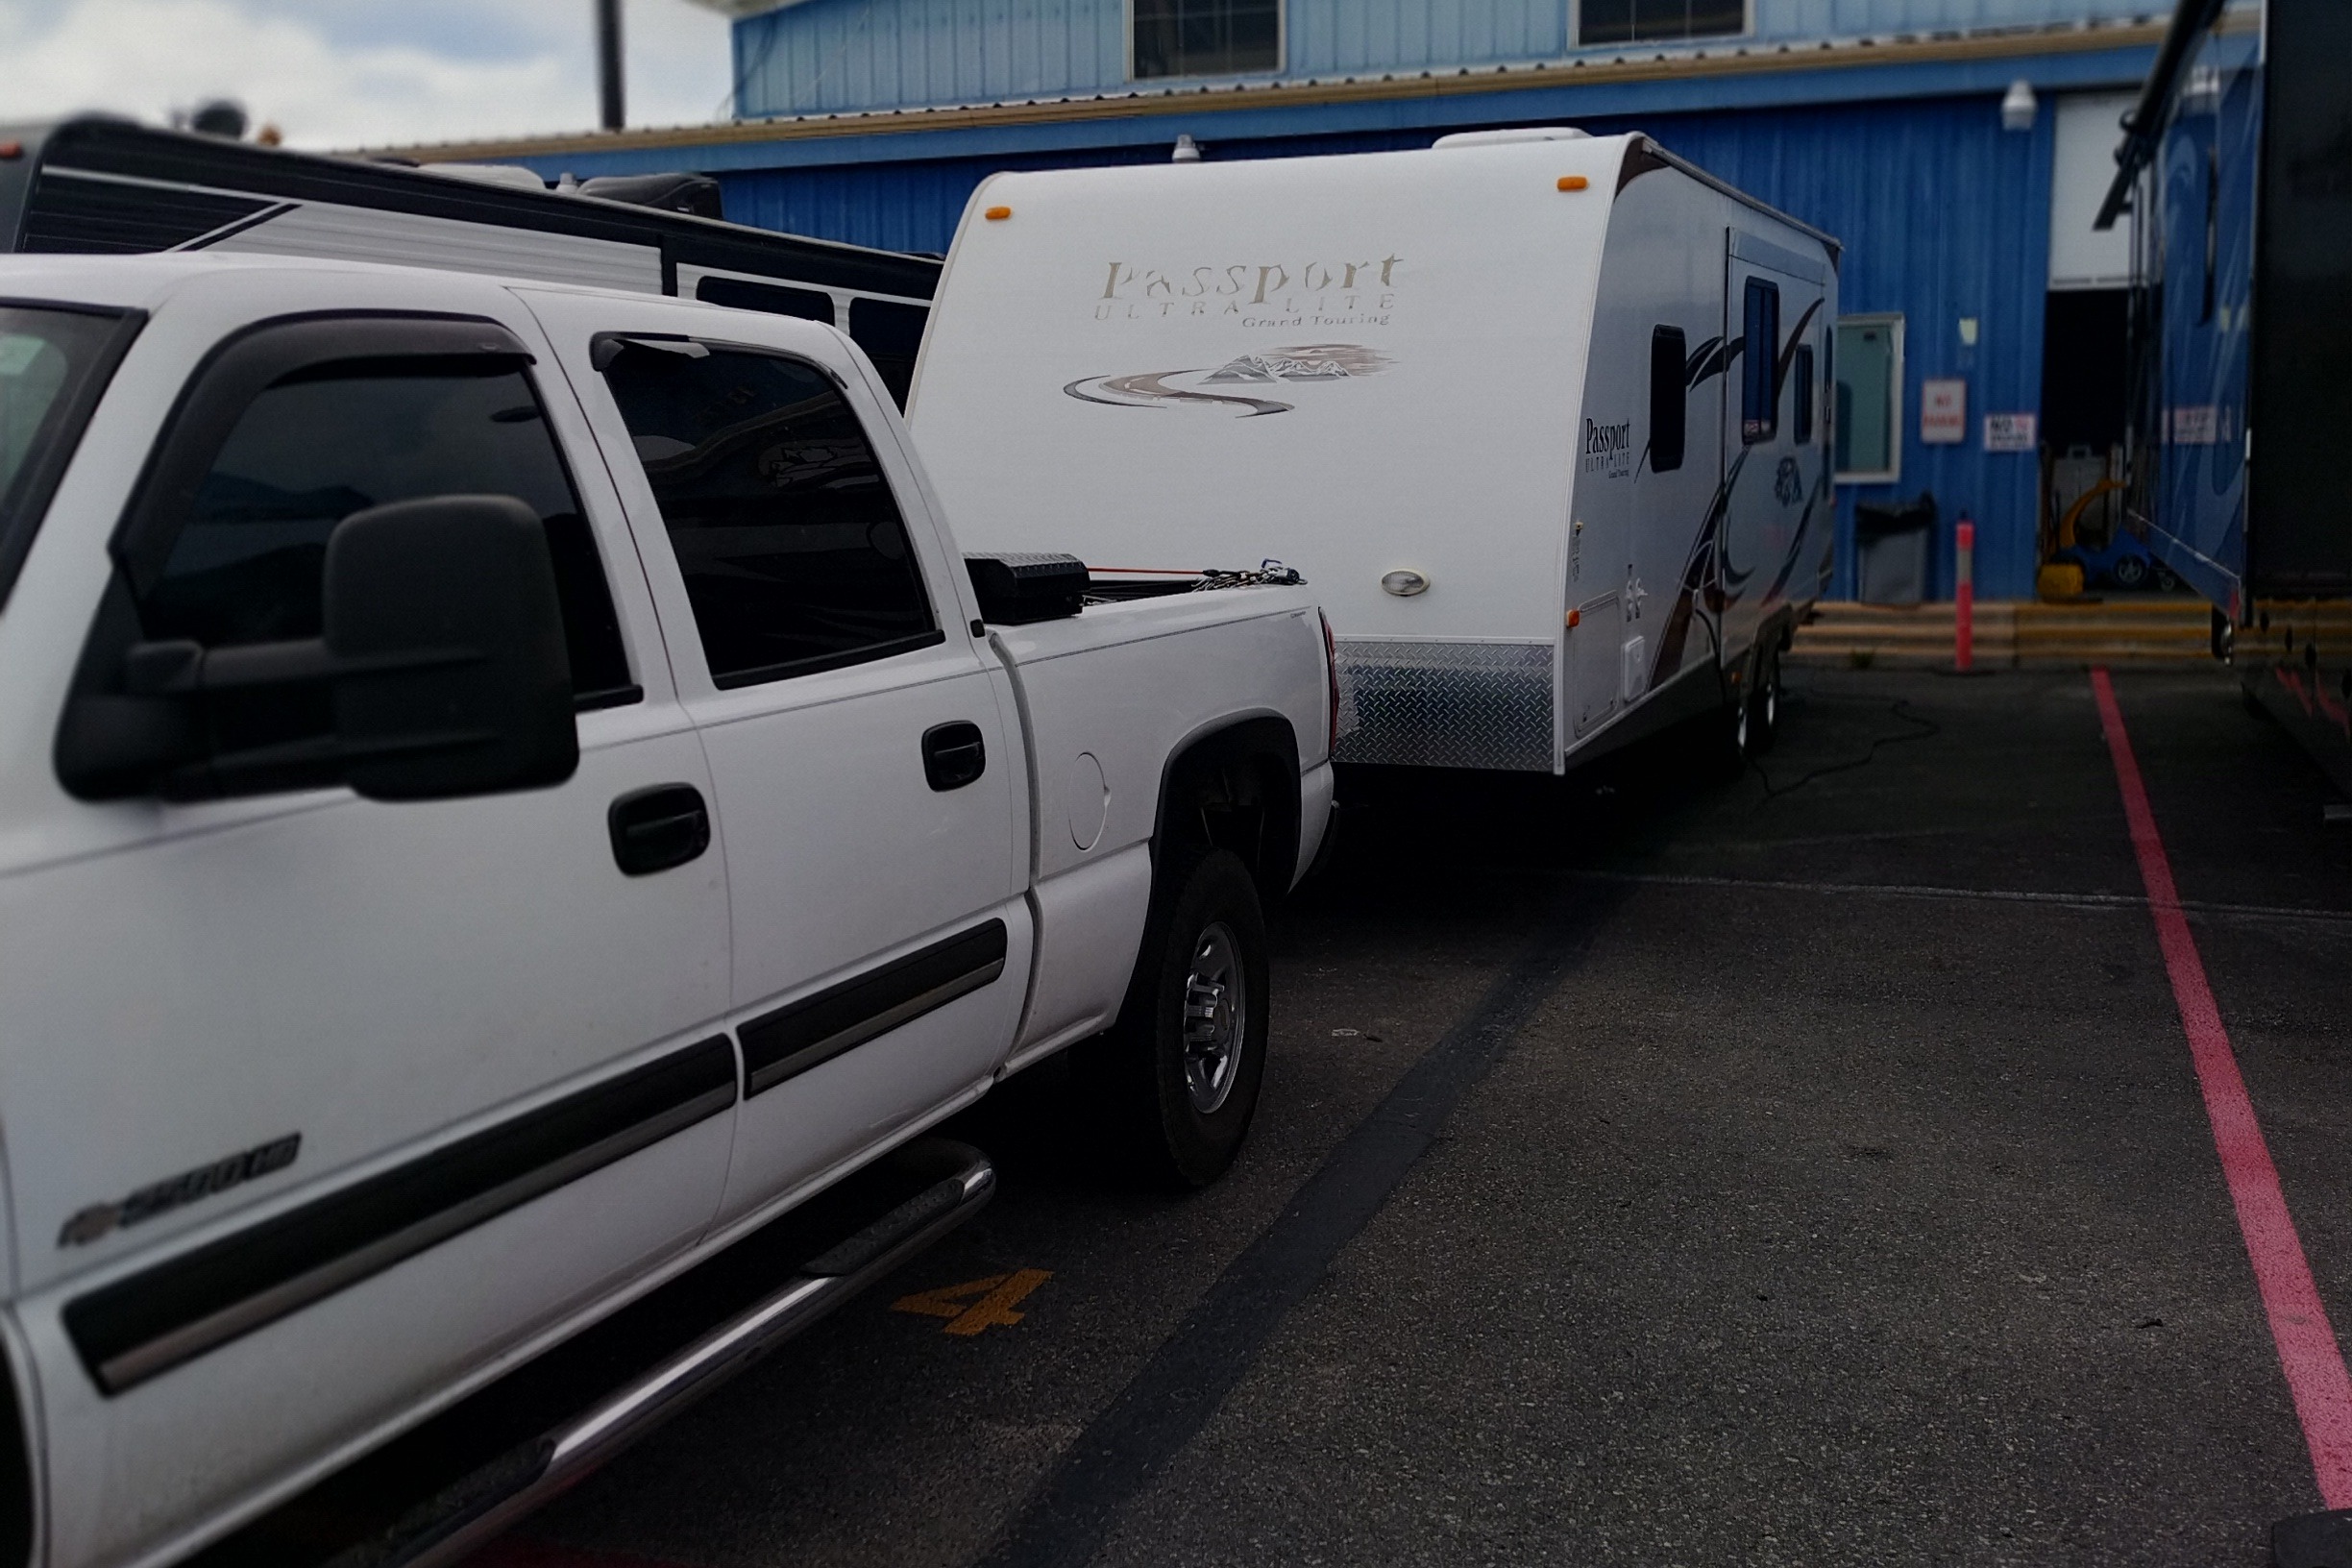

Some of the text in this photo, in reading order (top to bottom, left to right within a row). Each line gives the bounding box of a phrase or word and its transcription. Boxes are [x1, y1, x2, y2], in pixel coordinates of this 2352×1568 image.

[1098, 253, 1404, 306] Passport
[1094, 292, 1395, 321] ULTRA LITE
[1241, 313, 1392, 329] Grand Touring
[1585, 417, 1630, 461] Passport
[890, 1267, 1056, 1336] 4
